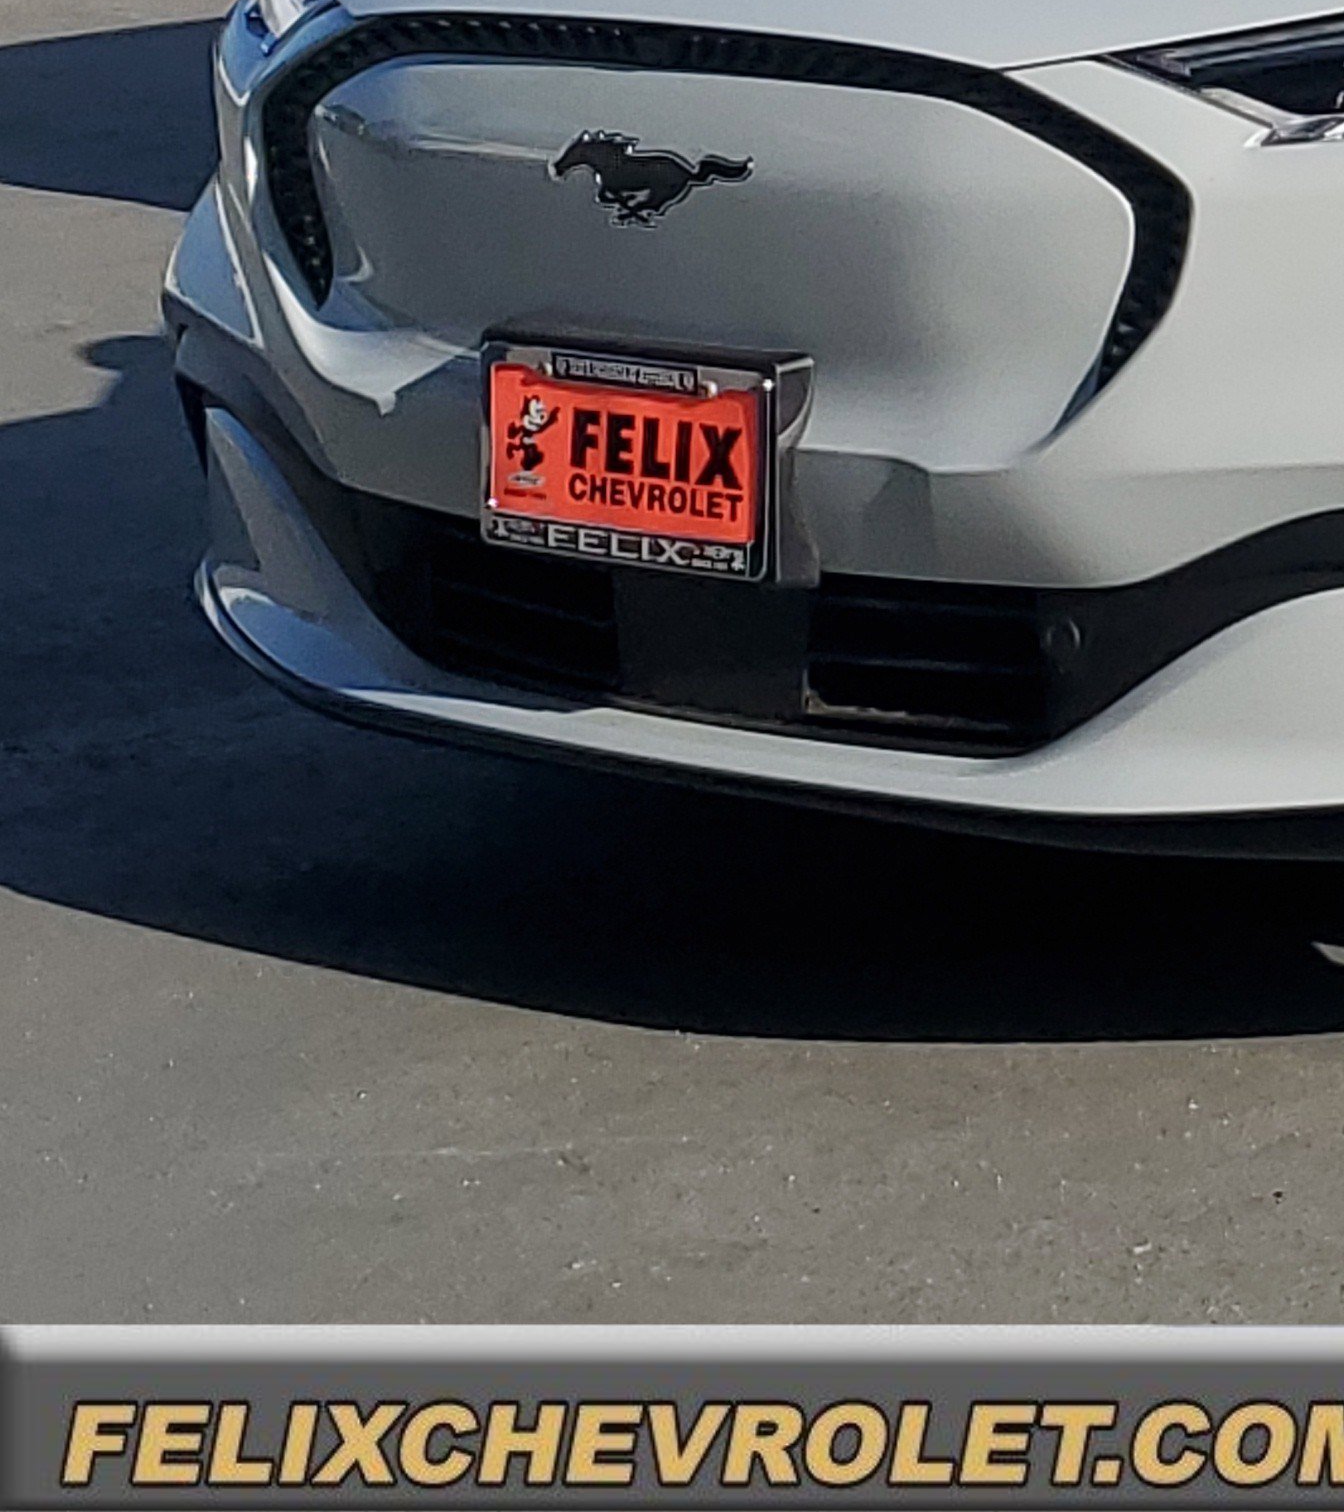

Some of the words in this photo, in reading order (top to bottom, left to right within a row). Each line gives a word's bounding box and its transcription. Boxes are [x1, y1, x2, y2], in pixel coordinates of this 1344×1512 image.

[570, 407, 743, 490] FELIX
[568, 473, 744, 522] CHEVROLET
[547, 524, 692, 565] FELIX
